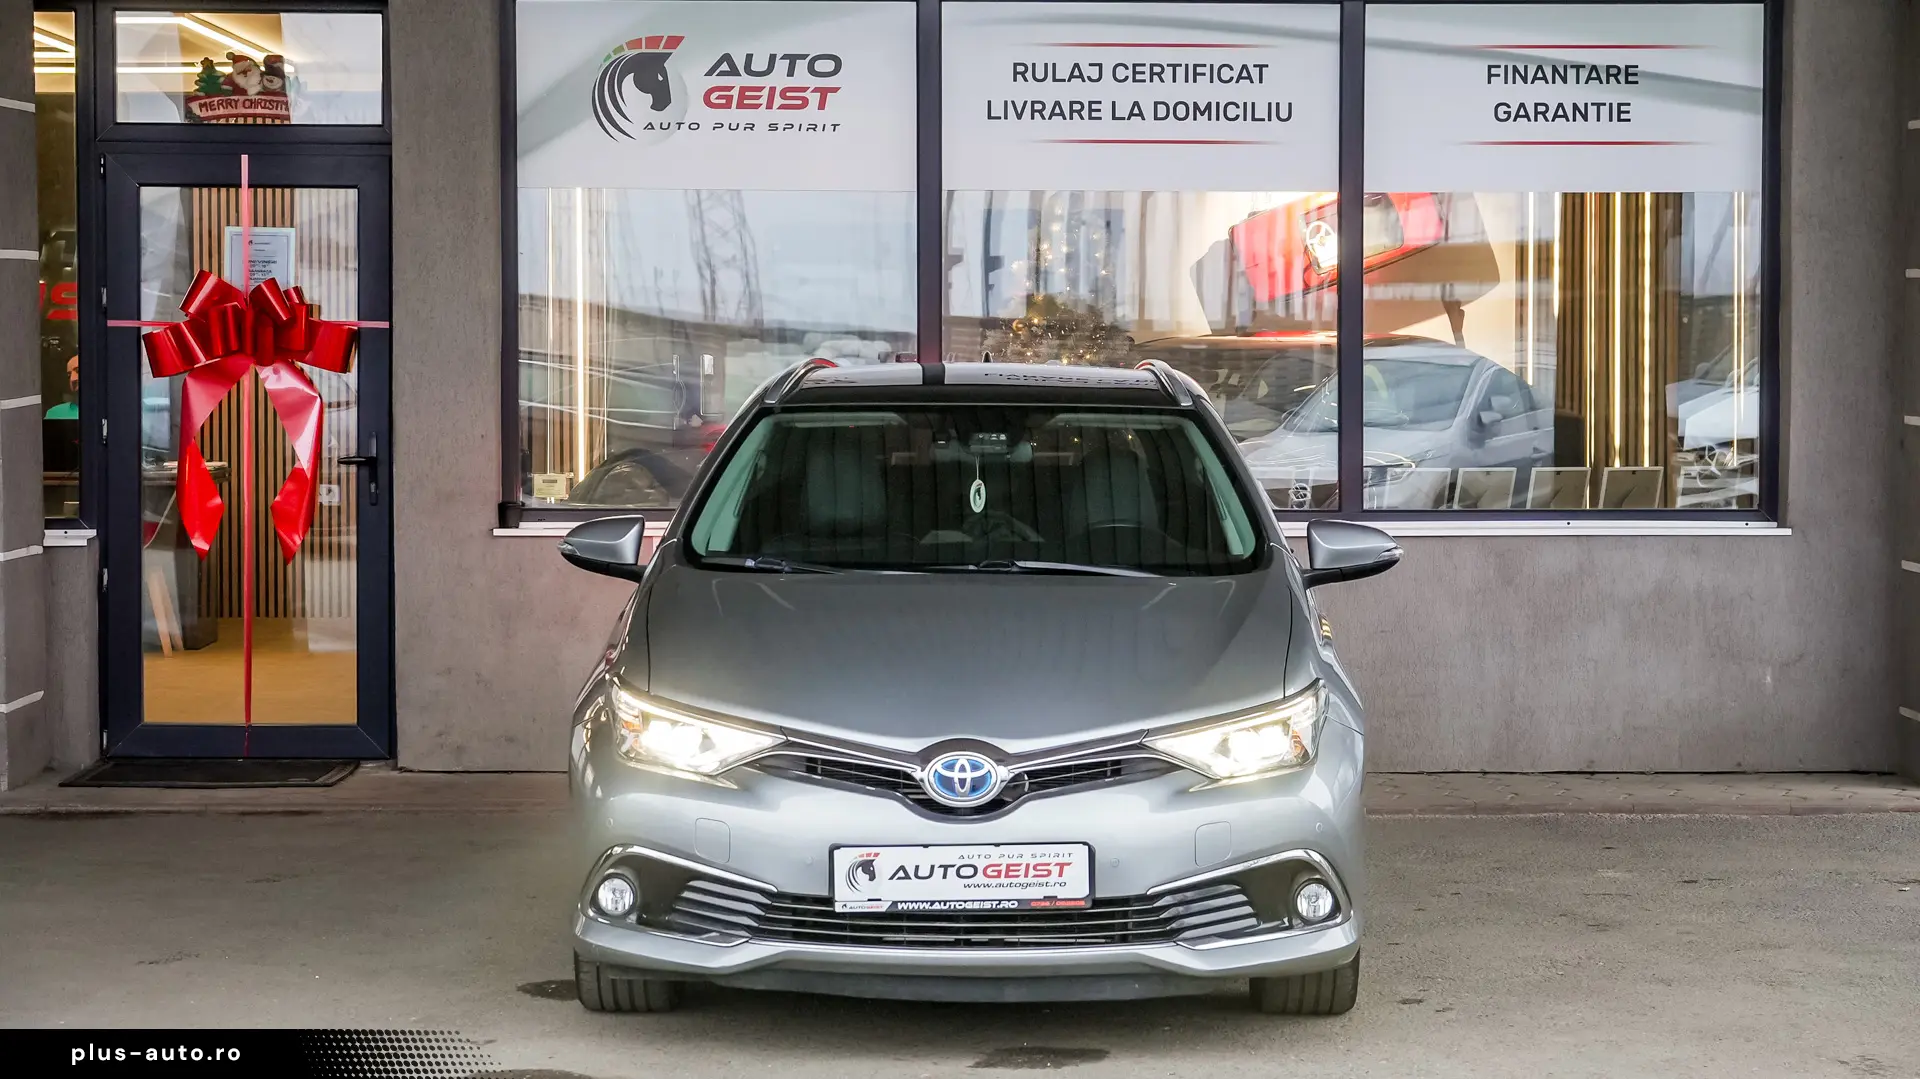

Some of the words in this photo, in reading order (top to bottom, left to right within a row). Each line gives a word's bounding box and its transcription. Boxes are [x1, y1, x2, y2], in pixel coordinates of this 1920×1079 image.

[704, 52, 842, 78] AUTO
[1012, 62, 1103, 83] RULAJ
[1111, 63, 1269, 84] CERTIFICAT
[1487, 64, 1639, 85] FINANTARE
[198, 98, 240, 113] MERRY
[703, 85, 842, 111] GEIST
[987, 100, 1102, 121] LIVRARE
[1111, 101, 1146, 121] LA
[1153, 101, 1293, 122] DOMICILIU
[1493, 102, 1632, 122] GARANTIE
[643, 121, 701, 131] AUTO
[712, 122, 756, 131] PUR
[768, 122, 841, 132] SPIRIT
[963, 880, 1067, 890] www.autogeist.ro
[897, 900, 1018, 910] WWW.AUTOGEIST.RO
